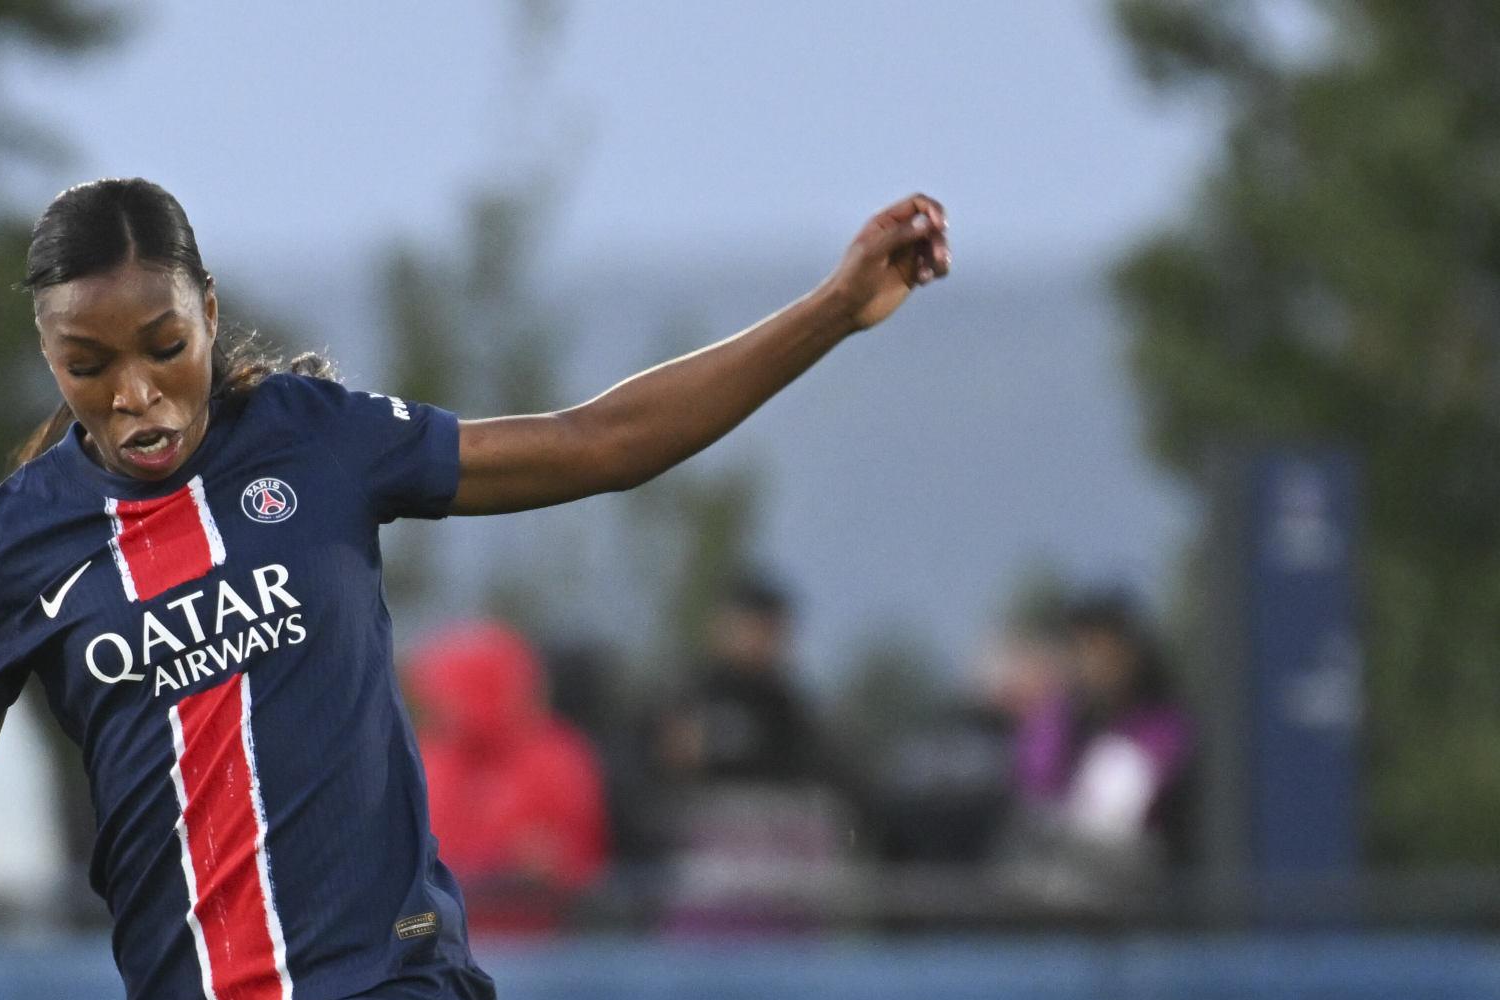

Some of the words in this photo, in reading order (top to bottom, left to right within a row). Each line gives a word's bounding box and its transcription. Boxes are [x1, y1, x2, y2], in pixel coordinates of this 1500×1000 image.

[246, 480, 280, 497] PARIS
[85, 563, 301, 684] QATAR
[154, 613, 307, 697] AIRWAYS
